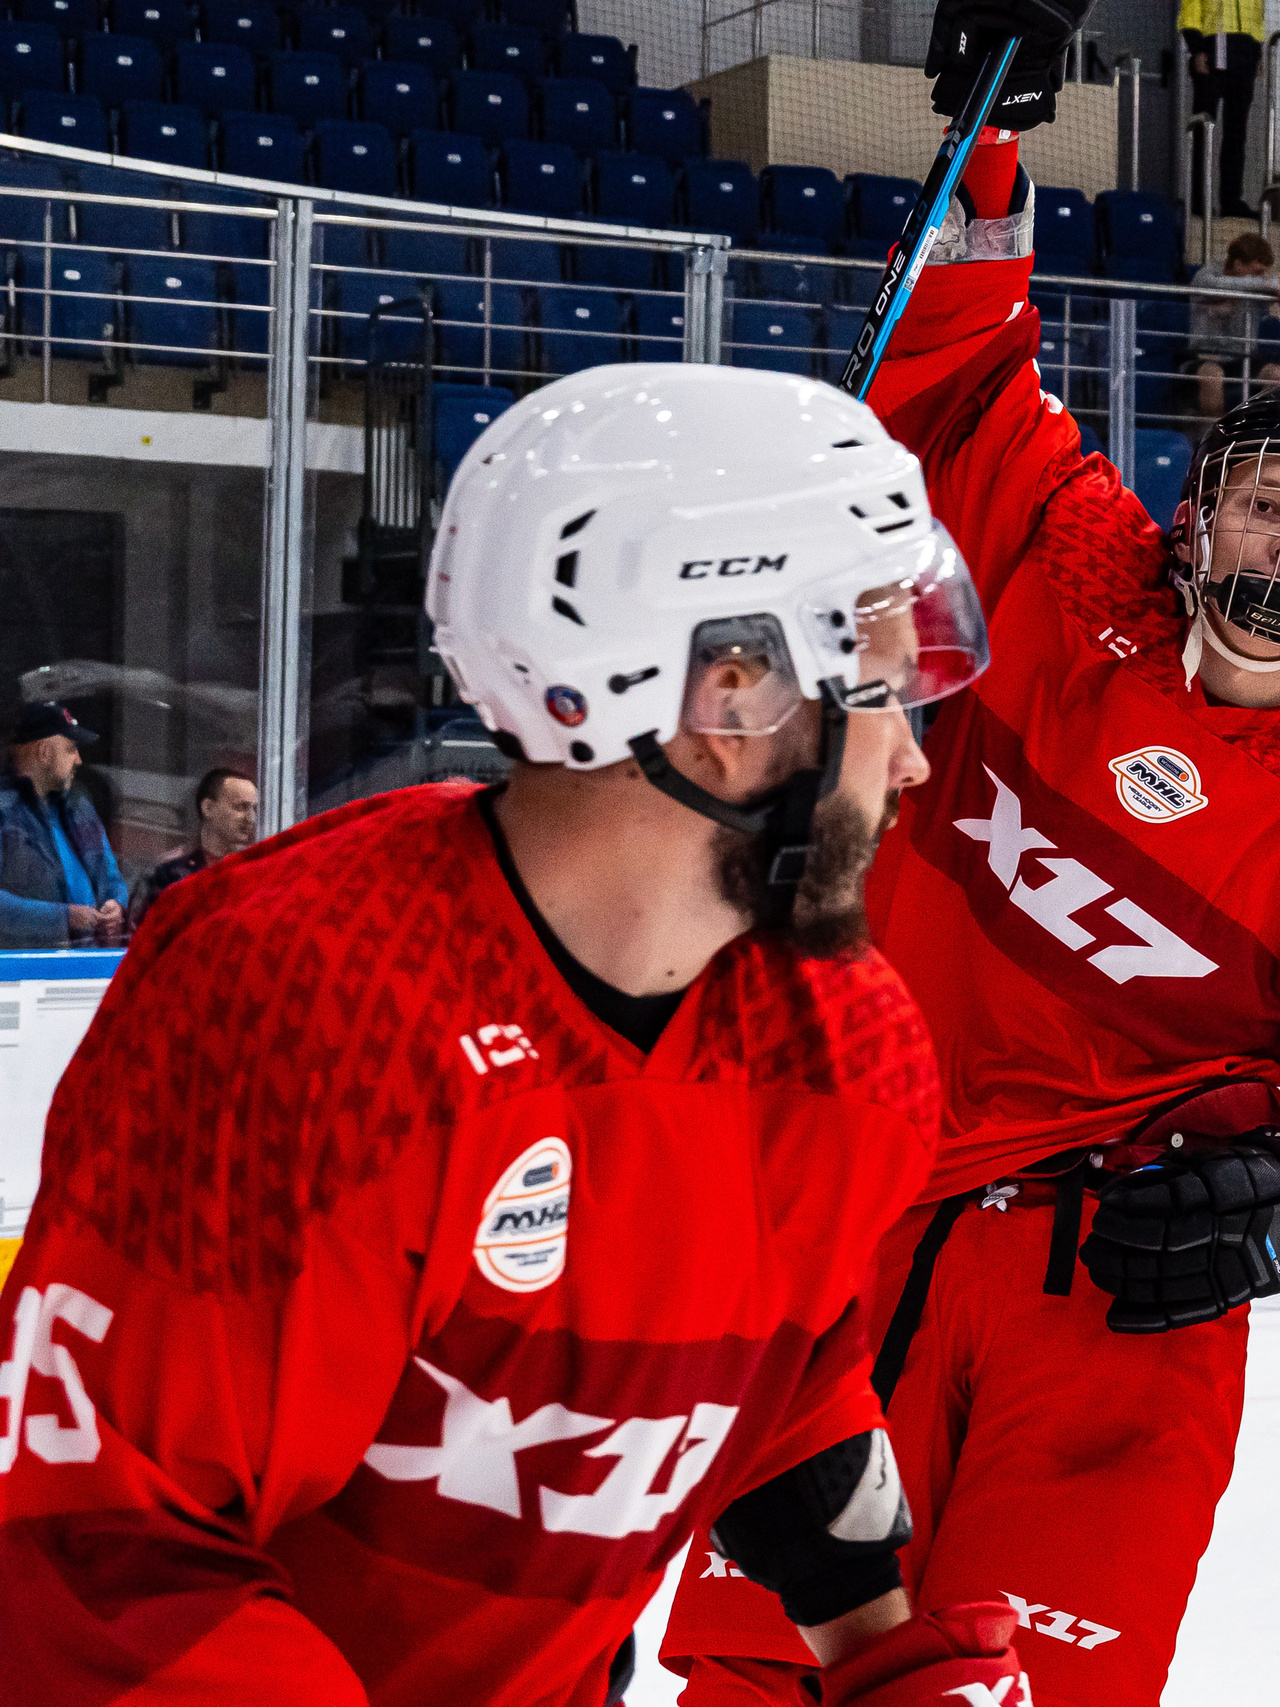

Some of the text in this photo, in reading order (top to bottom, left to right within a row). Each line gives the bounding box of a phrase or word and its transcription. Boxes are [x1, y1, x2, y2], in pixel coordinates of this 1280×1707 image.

[1002, 91, 1043, 106] NEXT
[839, 321, 876, 391] RO
[875, 250, 906, 316] ONE
[678, 554, 788, 580] CCM
[1127, 761, 1184, 808] MHL
[952, 760, 1220, 985] X17
[998, 1590, 1122, 1651] X17
